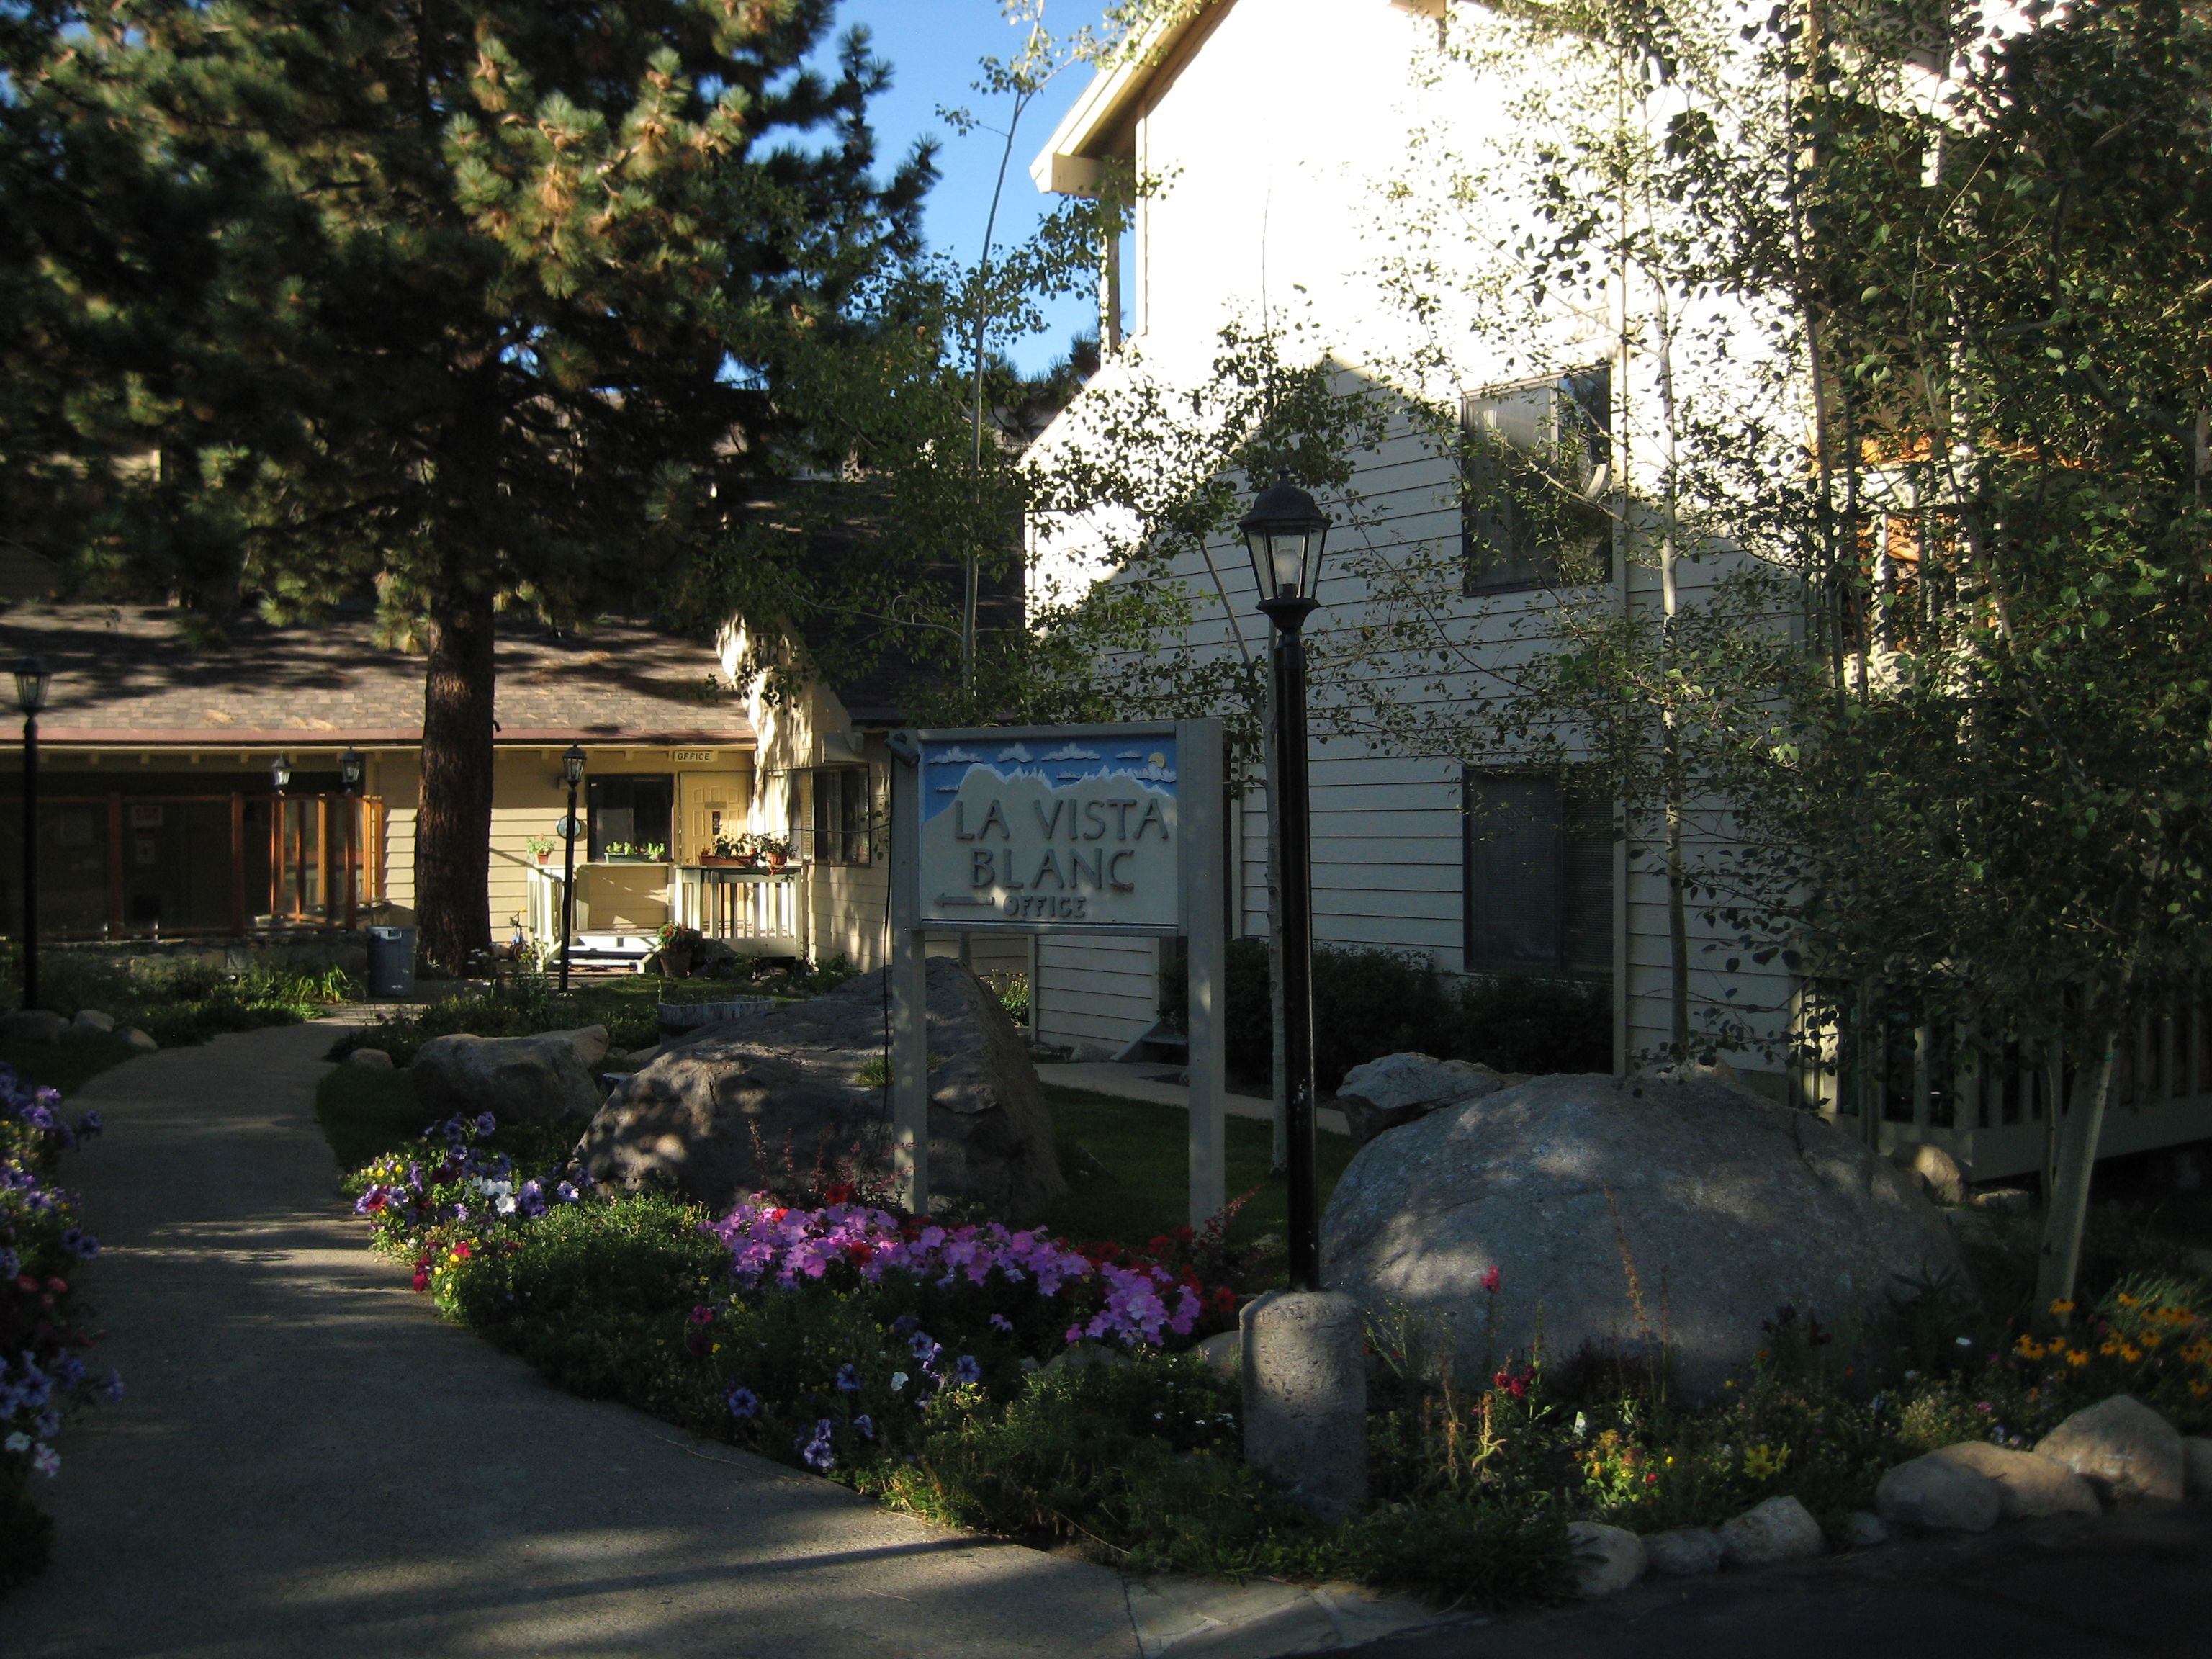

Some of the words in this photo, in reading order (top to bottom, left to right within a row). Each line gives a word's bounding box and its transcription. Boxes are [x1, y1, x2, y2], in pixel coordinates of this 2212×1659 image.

[956, 799, 1010, 840] LA
[1035, 798, 1169, 840] VISTA
[971, 848, 1134, 891] BLANC
[1004, 896, 1086, 918] OFFICE
